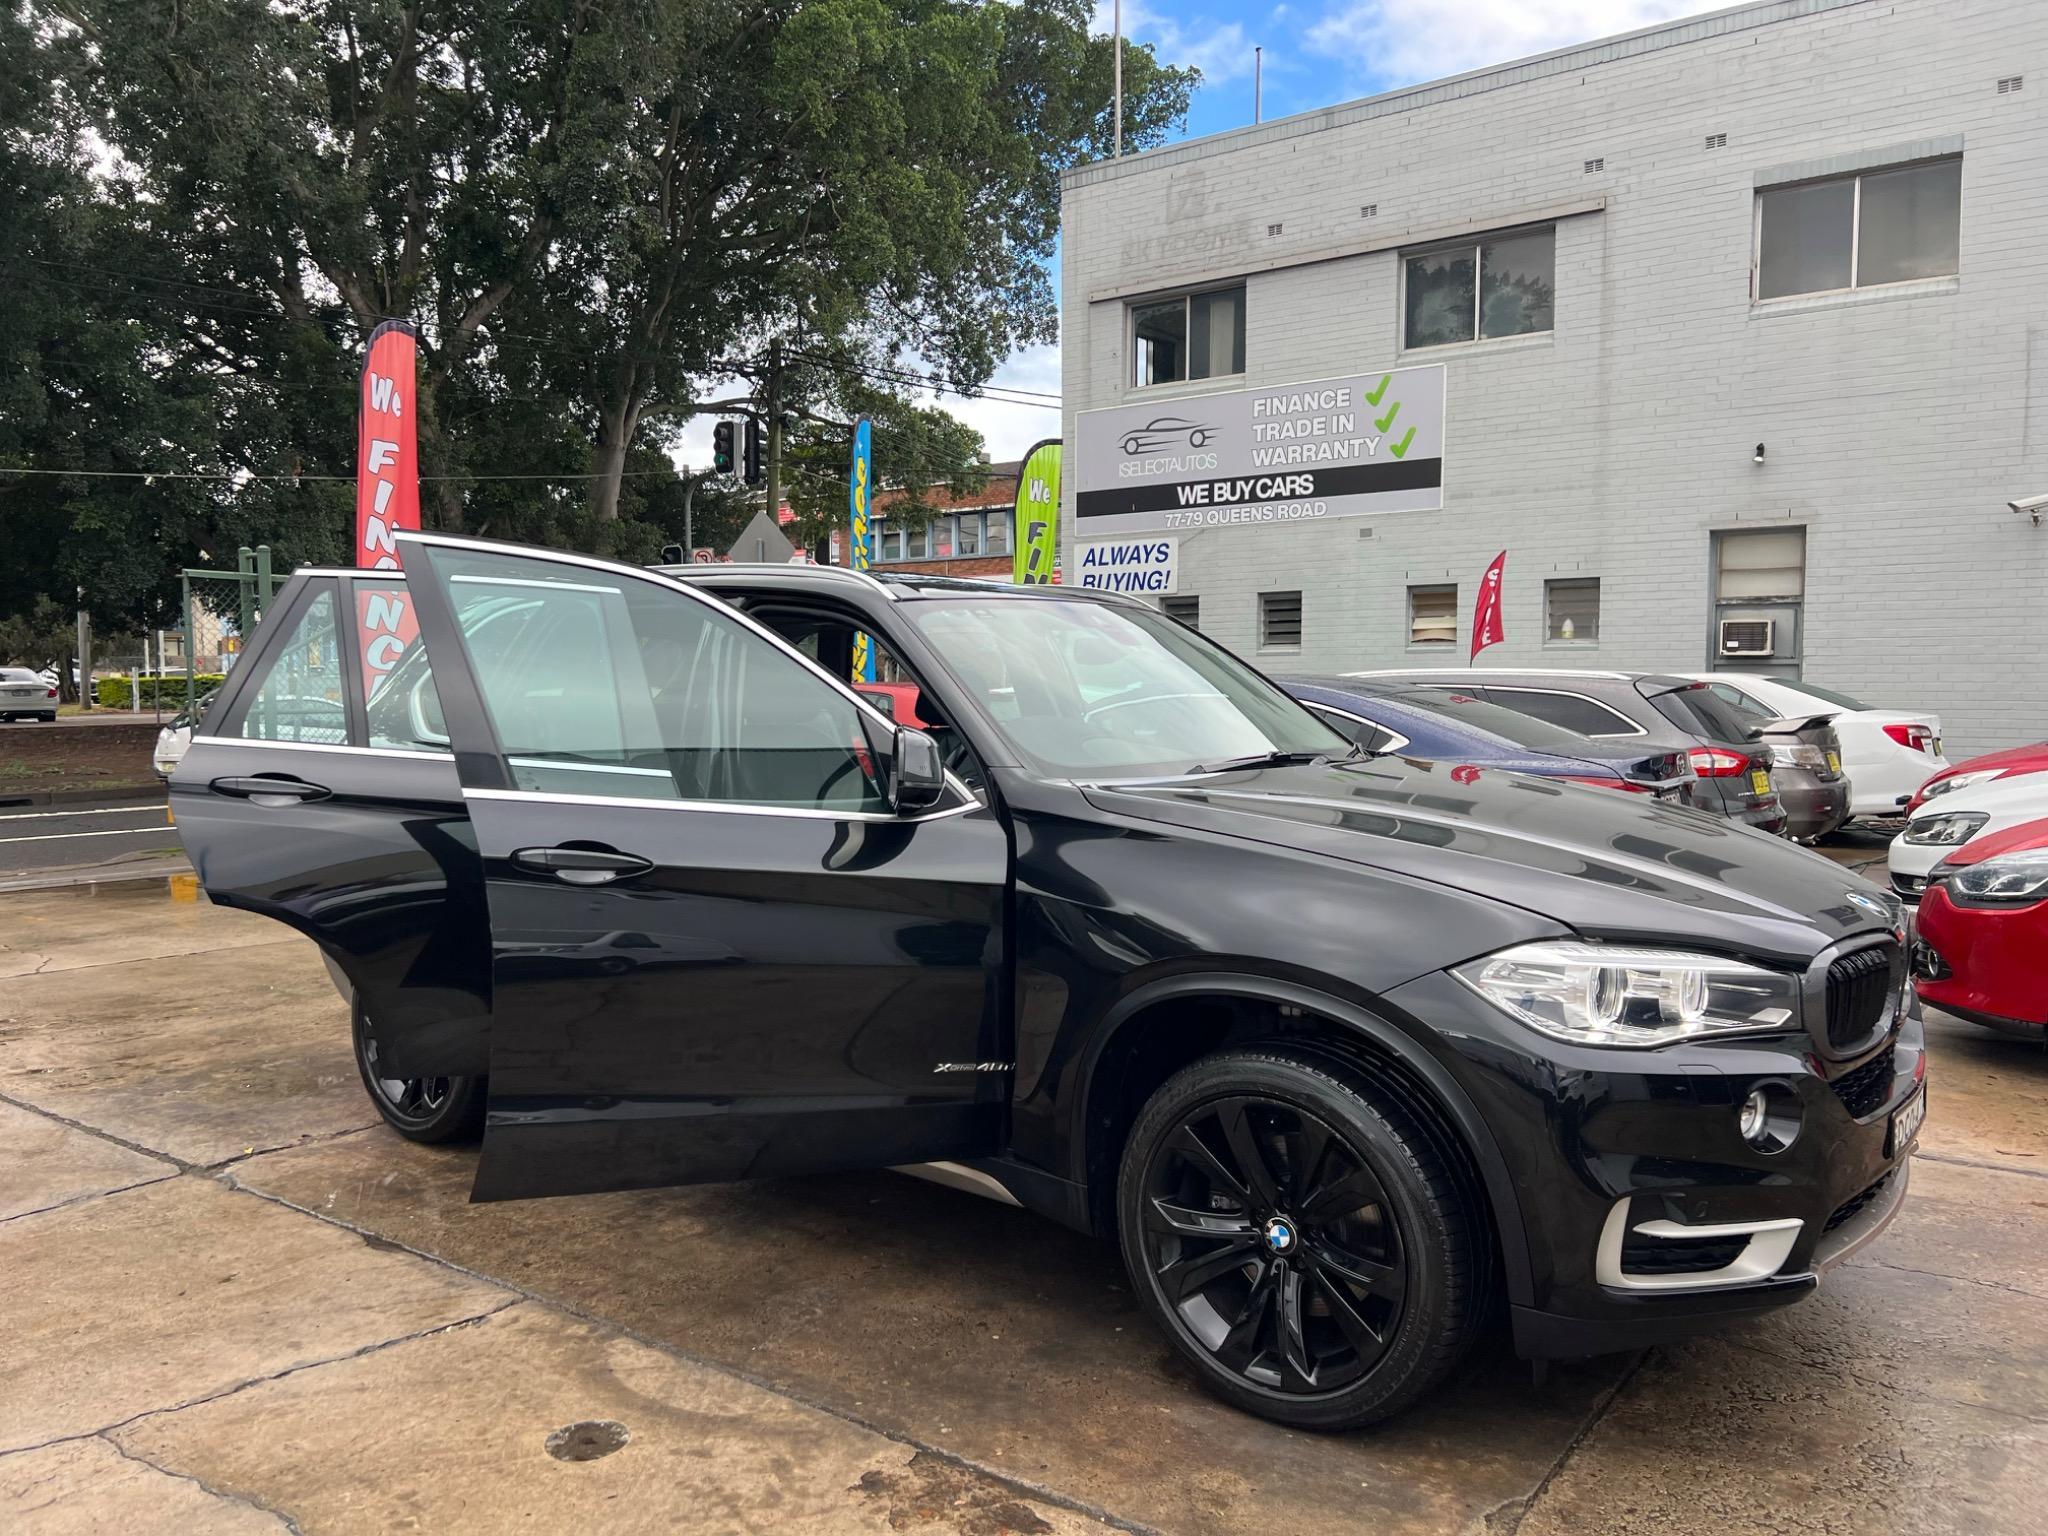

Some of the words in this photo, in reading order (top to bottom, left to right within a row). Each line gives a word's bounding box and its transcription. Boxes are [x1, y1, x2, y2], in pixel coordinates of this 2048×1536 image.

[1252, 387, 1351, 418] FINANCE
[1252, 416, 1327, 442] TRADE
[1331, 412, 1355, 435] IN
[1251, 436, 1382, 468] WARRANTY
[1029, 478, 1051, 505] We
[1177, 484, 1210, 505] WE
[1213, 479, 1255, 502] BUY
[1255, 474, 1315, 499] CARS
[1165, 511, 1204, 528] 77-79
[1206, 505, 1274, 525] QUEENS
[1277, 501, 1327, 520] ROAD
[1082, 543, 1170, 567] ALWAYS
[1083, 570, 1171, 592] BUYING!
